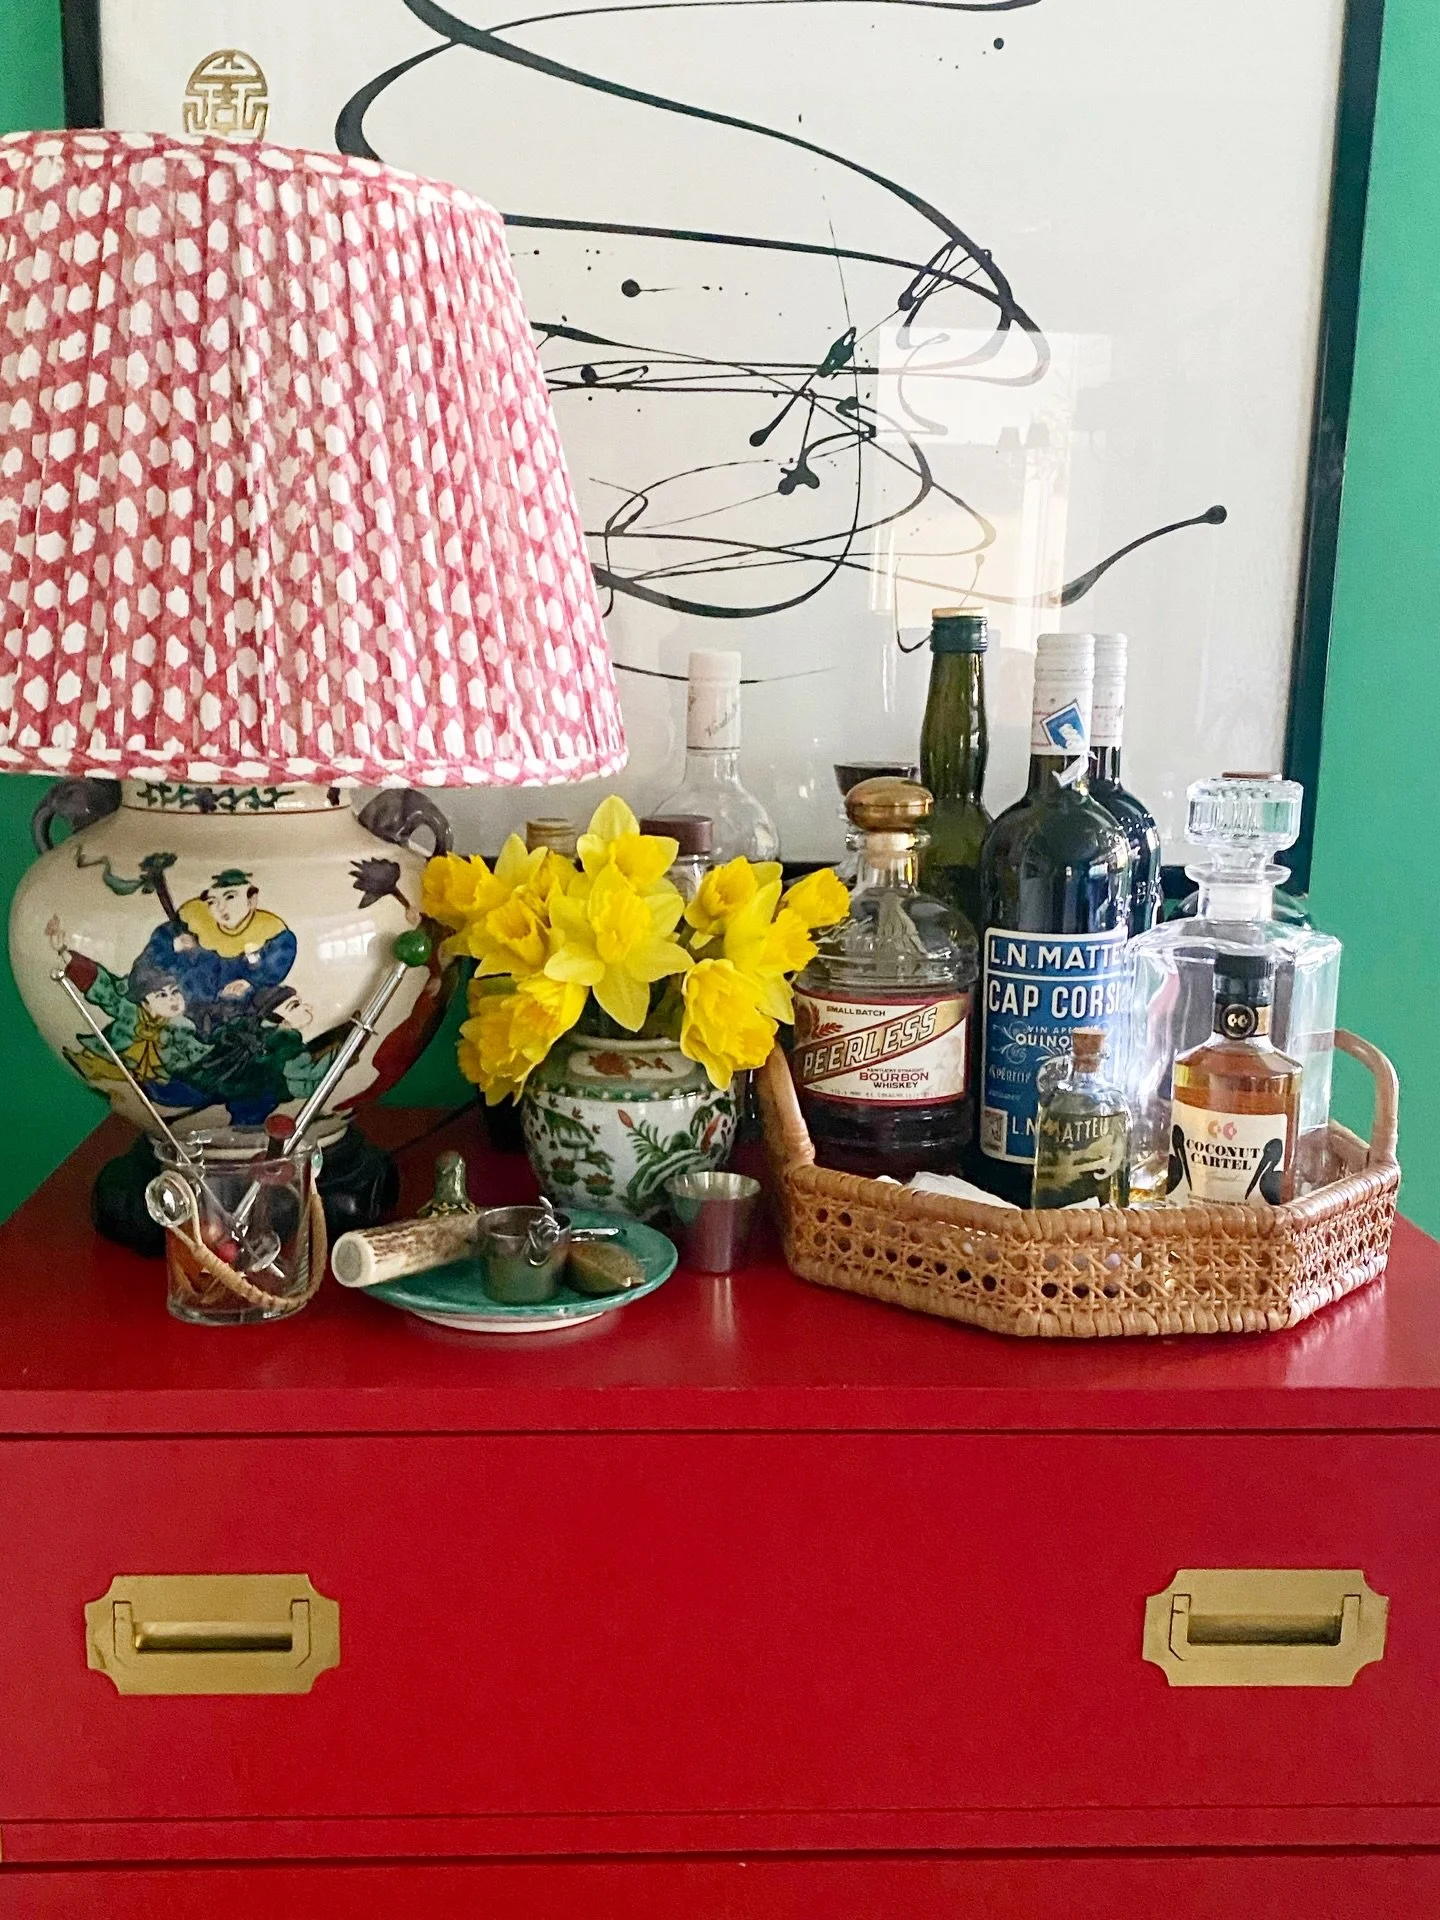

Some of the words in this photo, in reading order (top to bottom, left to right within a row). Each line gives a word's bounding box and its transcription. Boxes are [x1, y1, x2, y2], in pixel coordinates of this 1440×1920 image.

[990, 940, 1123, 970] L.N.MATTE
[988, 979, 1039, 1017] CAP
[827, 1005, 855, 1015] SMALL
[856, 1008, 886, 1017] BATCH
[803, 1006, 938, 1077] PEERLESS
[859, 1071, 929, 1082] BOURBON
[873, 1081, 918, 1089] WHISKEY
[1186, 1138, 1260, 1159] COCONUT
[1190, 1152, 1252, 1171] CARTEL
